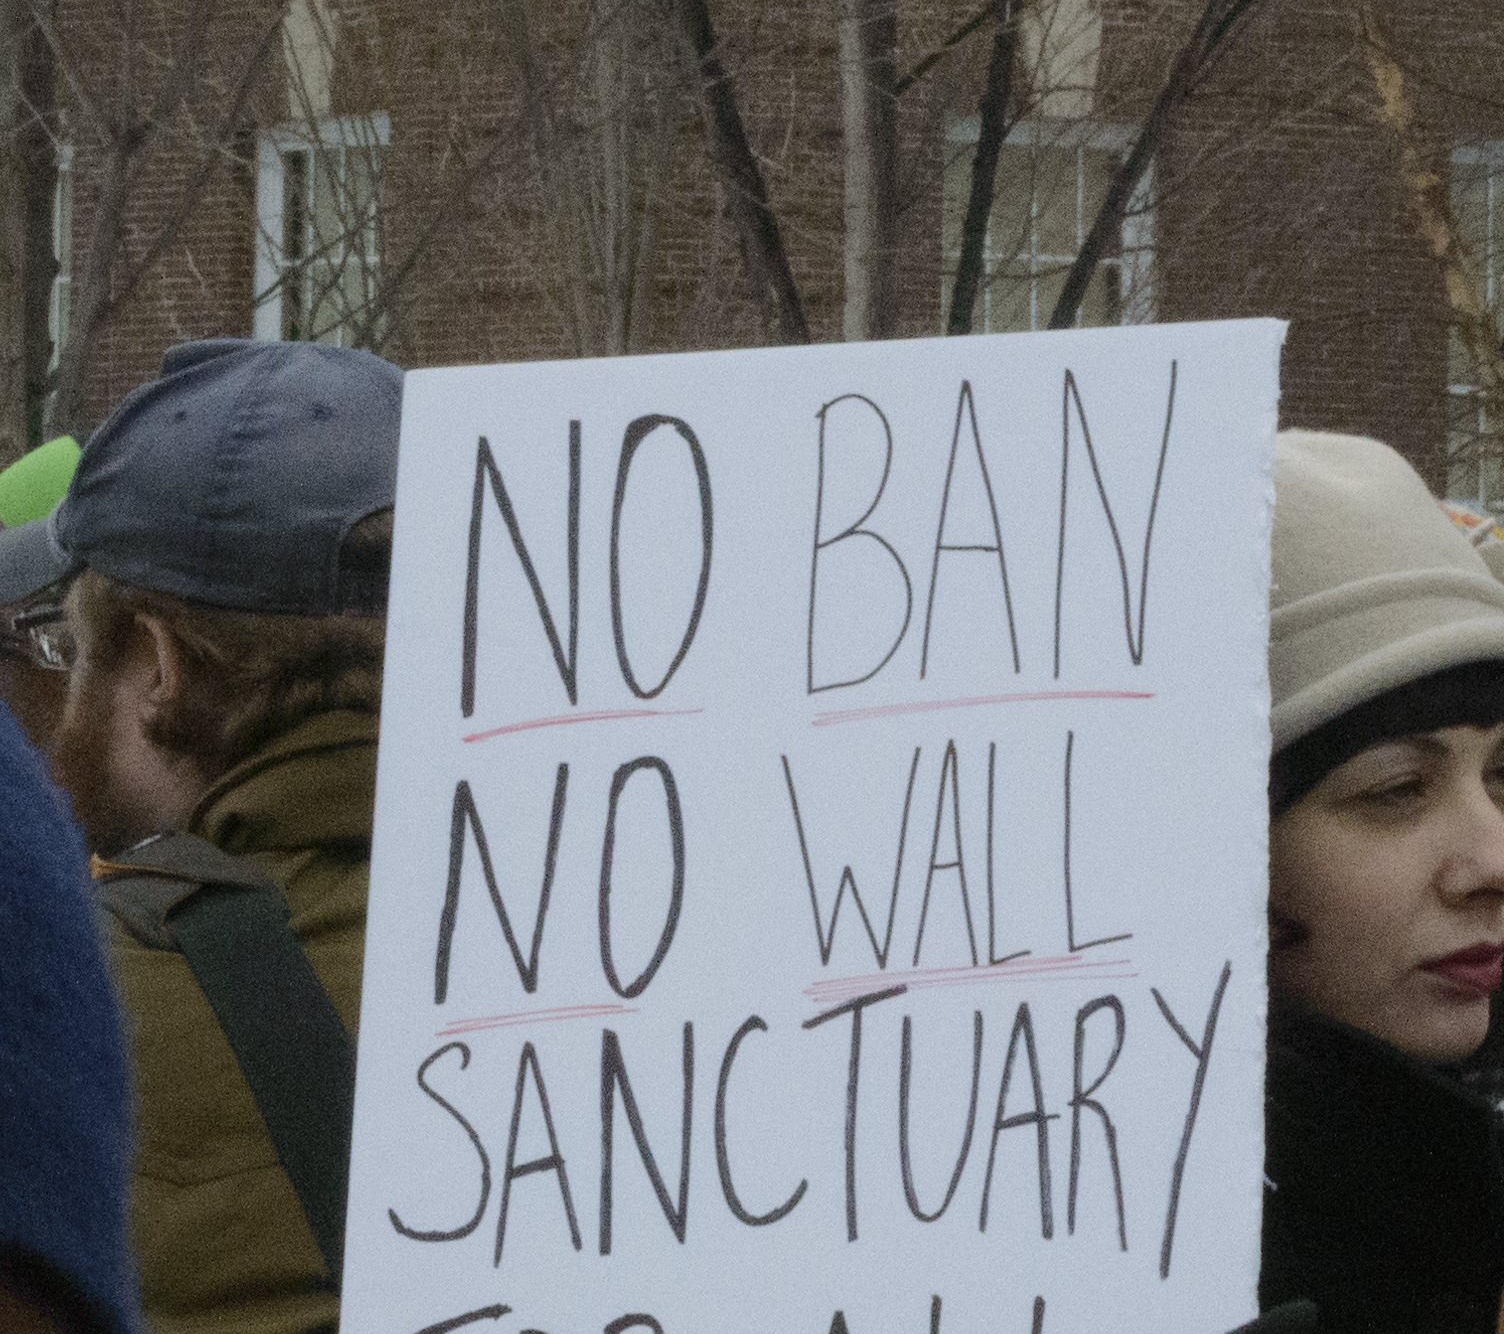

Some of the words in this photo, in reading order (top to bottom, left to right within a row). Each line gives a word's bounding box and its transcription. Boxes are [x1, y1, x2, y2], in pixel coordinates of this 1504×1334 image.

[459, 411, 714, 720] NO
[806, 358, 1179, 696] BAN
[432, 754, 687, 1007] NO
[780, 729, 1134, 971] WALL
[386, 960, 1233, 1281] SANCTUARY
